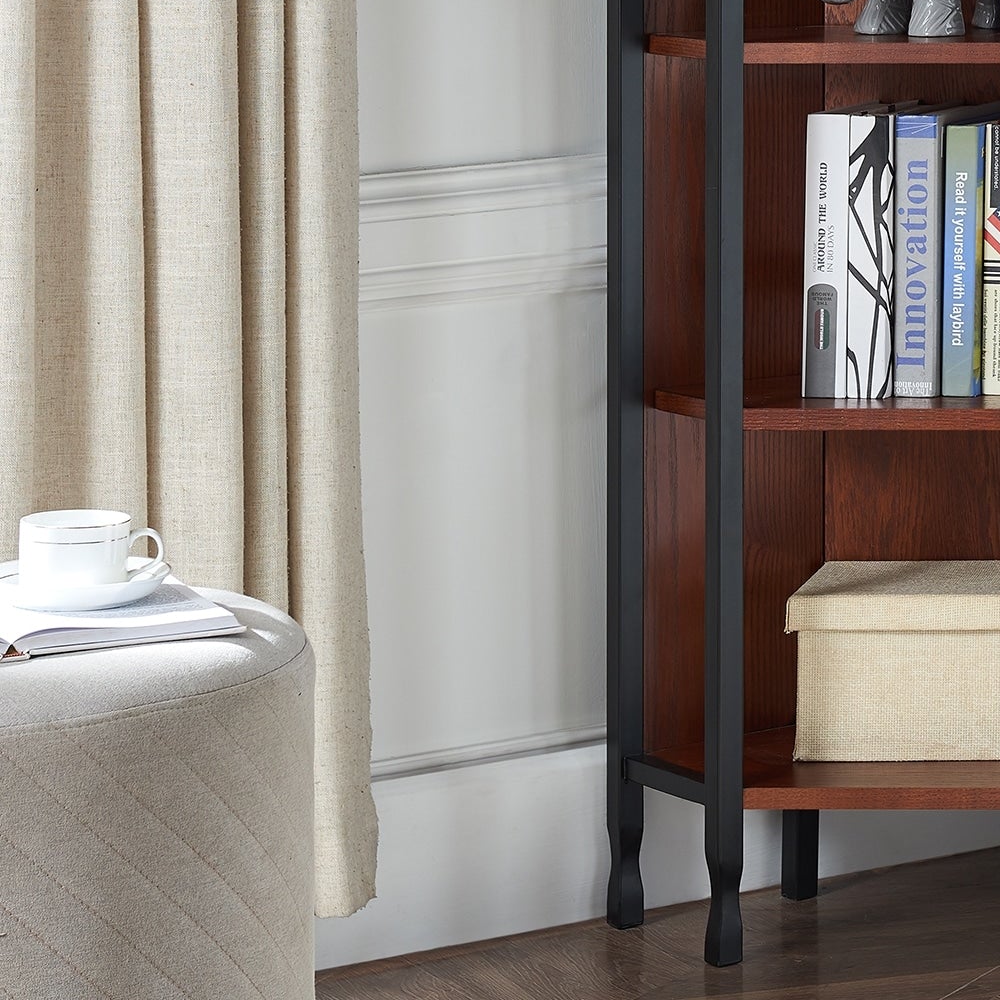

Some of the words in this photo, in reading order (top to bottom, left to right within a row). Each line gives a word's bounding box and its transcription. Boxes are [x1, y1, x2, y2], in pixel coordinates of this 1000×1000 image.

[818, 162, 828, 200] WORLD
[955, 171, 968, 204] Read
[818, 203, 827, 224] THE
[957, 206, 967, 218] it
[817, 227, 826, 273] AROUND
[827, 225, 835, 248] DAYS
[952, 219, 967, 277] yourself
[826, 249, 834, 261] 80
[826, 261, 834, 273] IN
[895, 158, 929, 369] Innovation
[953, 279, 965, 301] with
[950, 302, 964, 346] laybird
